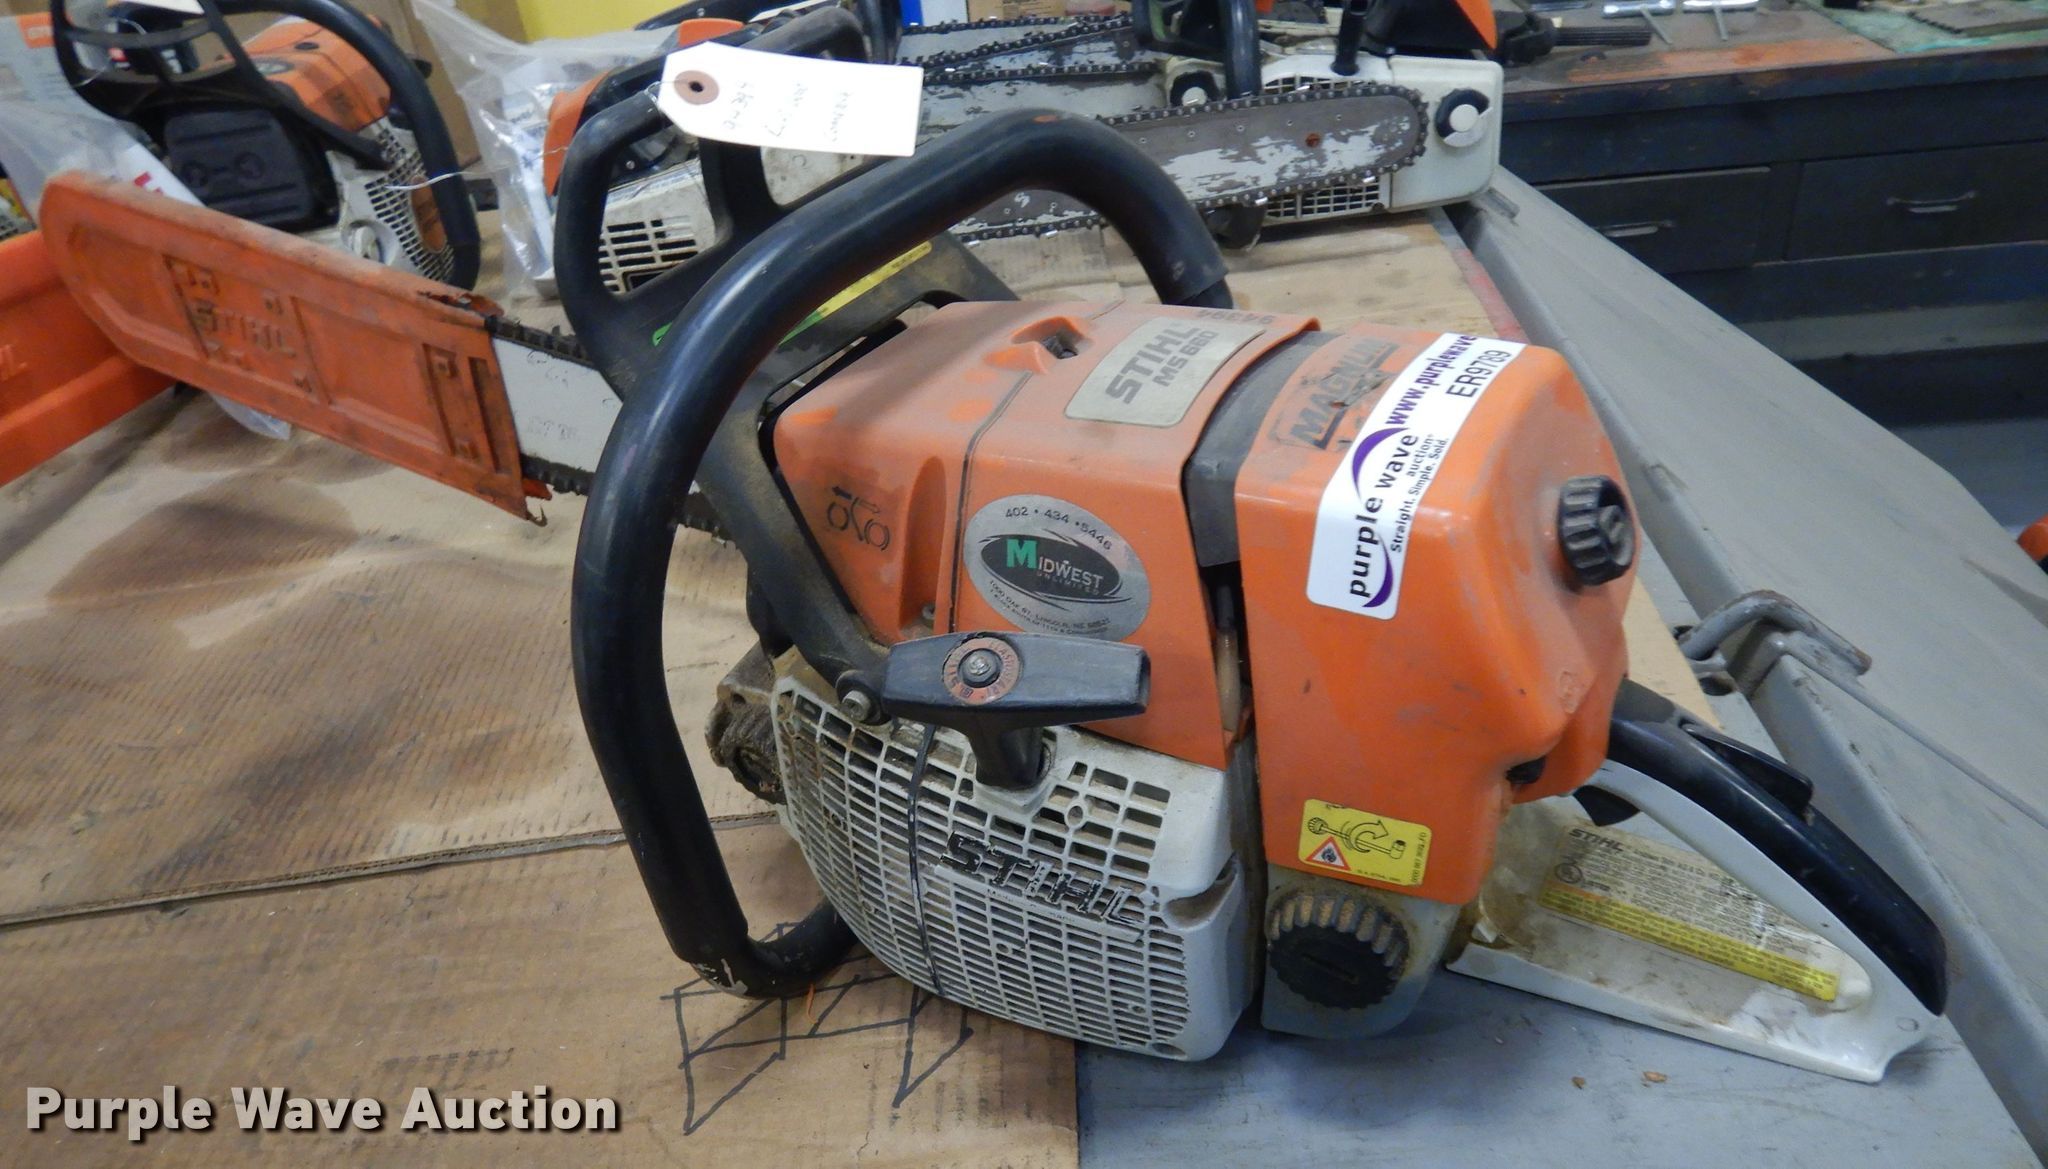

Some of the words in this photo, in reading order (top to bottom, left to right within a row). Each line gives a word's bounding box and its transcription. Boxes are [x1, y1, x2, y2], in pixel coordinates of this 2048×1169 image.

[1104, 327, 1201, 405] STIHL
[1152, 355, 1189, 388] MS
[1185, 330, 1220, 358] 660
[1445, 349, 1512, 399] ER9789
[1406, 437, 1435, 477] auction
[1005, 506, 1029, 519] 402
[1044, 508, 1070, 524] 434
[1350, 497, 1384, 598] purple
[1374, 434, 1419, 488] wave
[1005, 538, 1104, 588] MIDWEST
[1568, 828, 1624, 852] STIHL
[938, 830, 1145, 925] STIHL
